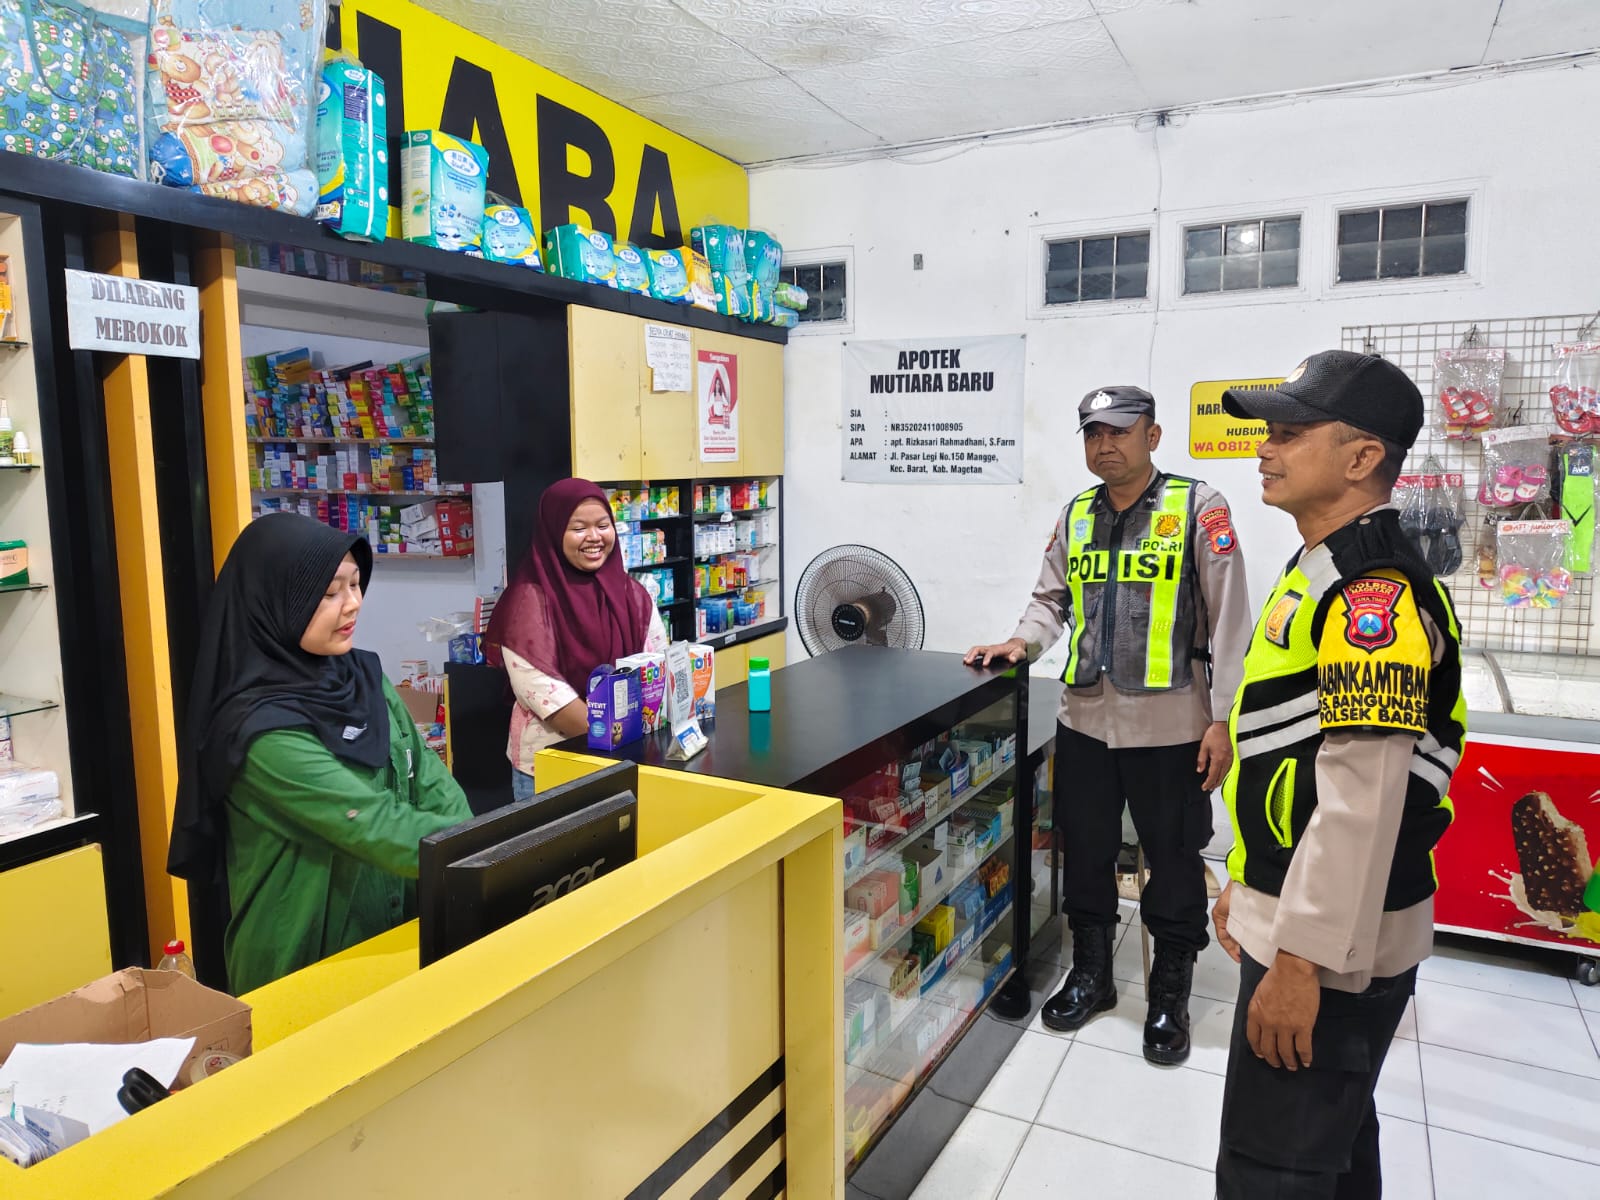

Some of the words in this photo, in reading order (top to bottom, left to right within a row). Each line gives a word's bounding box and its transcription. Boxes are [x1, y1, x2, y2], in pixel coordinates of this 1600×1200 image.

[90, 276, 185, 312] DILARANG
[95, 316, 188, 348] MEROKOK
[897, 349, 960, 370] APOTEK
[870, 373, 943, 393] MUTIARA
[947, 372, 994, 392] BARU
[850, 409, 862, 418] SIA
[850, 423, 865, 432] SIPA
[850, 438, 863, 446] APA
[890, 438, 904, 448] apt.
[906, 437, 938, 446] Rizkasari
[940, 437, 987, 448] Rahmadhani,
[989, 437, 1016, 447] S.Farm
[1194, 442, 1214, 452] WA
[1217, 441, 1250, 452] 0812
[850, 452, 877, 461] ALAMAT
[890, 452, 899, 461] Jl.
[900, 452, 920, 461] Pasar
[922, 452, 937, 463] Legi
[939, 452, 965, 461] No.150
[966, 452, 999, 464] Mangge,
[890, 465, 905, 473] Kec.
[906, 465, 928, 474] Barat,
[932, 465, 949, 474] Kab.
[950, 465, 983, 475] Magetan
[1142, 540, 1182, 552] POLRI
[1349, 581, 1394, 592] POLRES
[1320, 708, 1371, 724] POLSEK
[528, 857, 605, 914] acer
